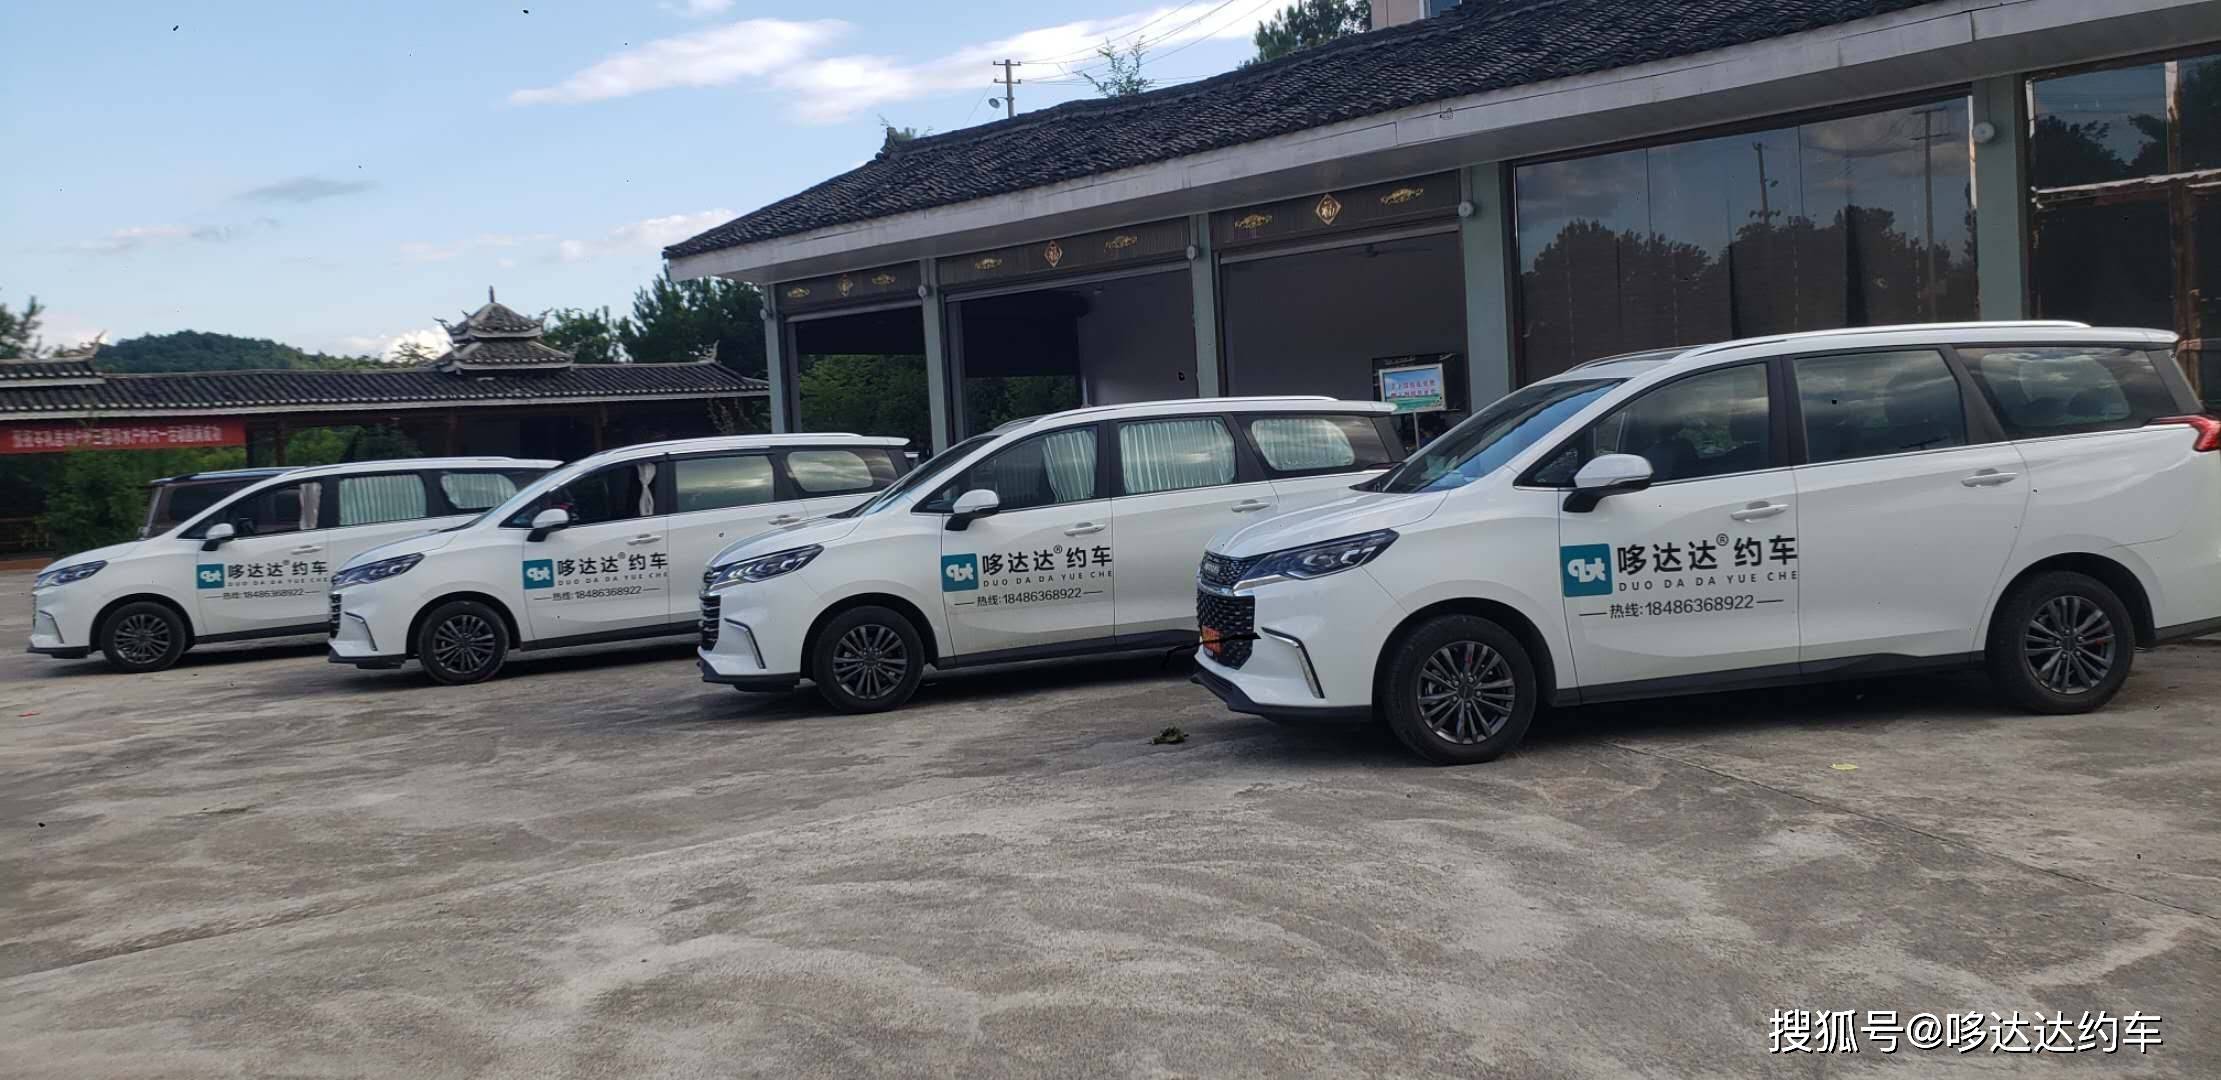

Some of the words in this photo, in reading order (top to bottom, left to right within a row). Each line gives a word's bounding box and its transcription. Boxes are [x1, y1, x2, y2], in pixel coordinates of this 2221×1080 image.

[984, 579, 1008, 587] DUO
[1619, 581, 1653, 592] DUO
[1664, 578, 1684, 588] DA
[1696, 576, 1716, 586] DA
[1726, 574, 1757, 583] YUE
[1767, 571, 1797, 581] CHE
